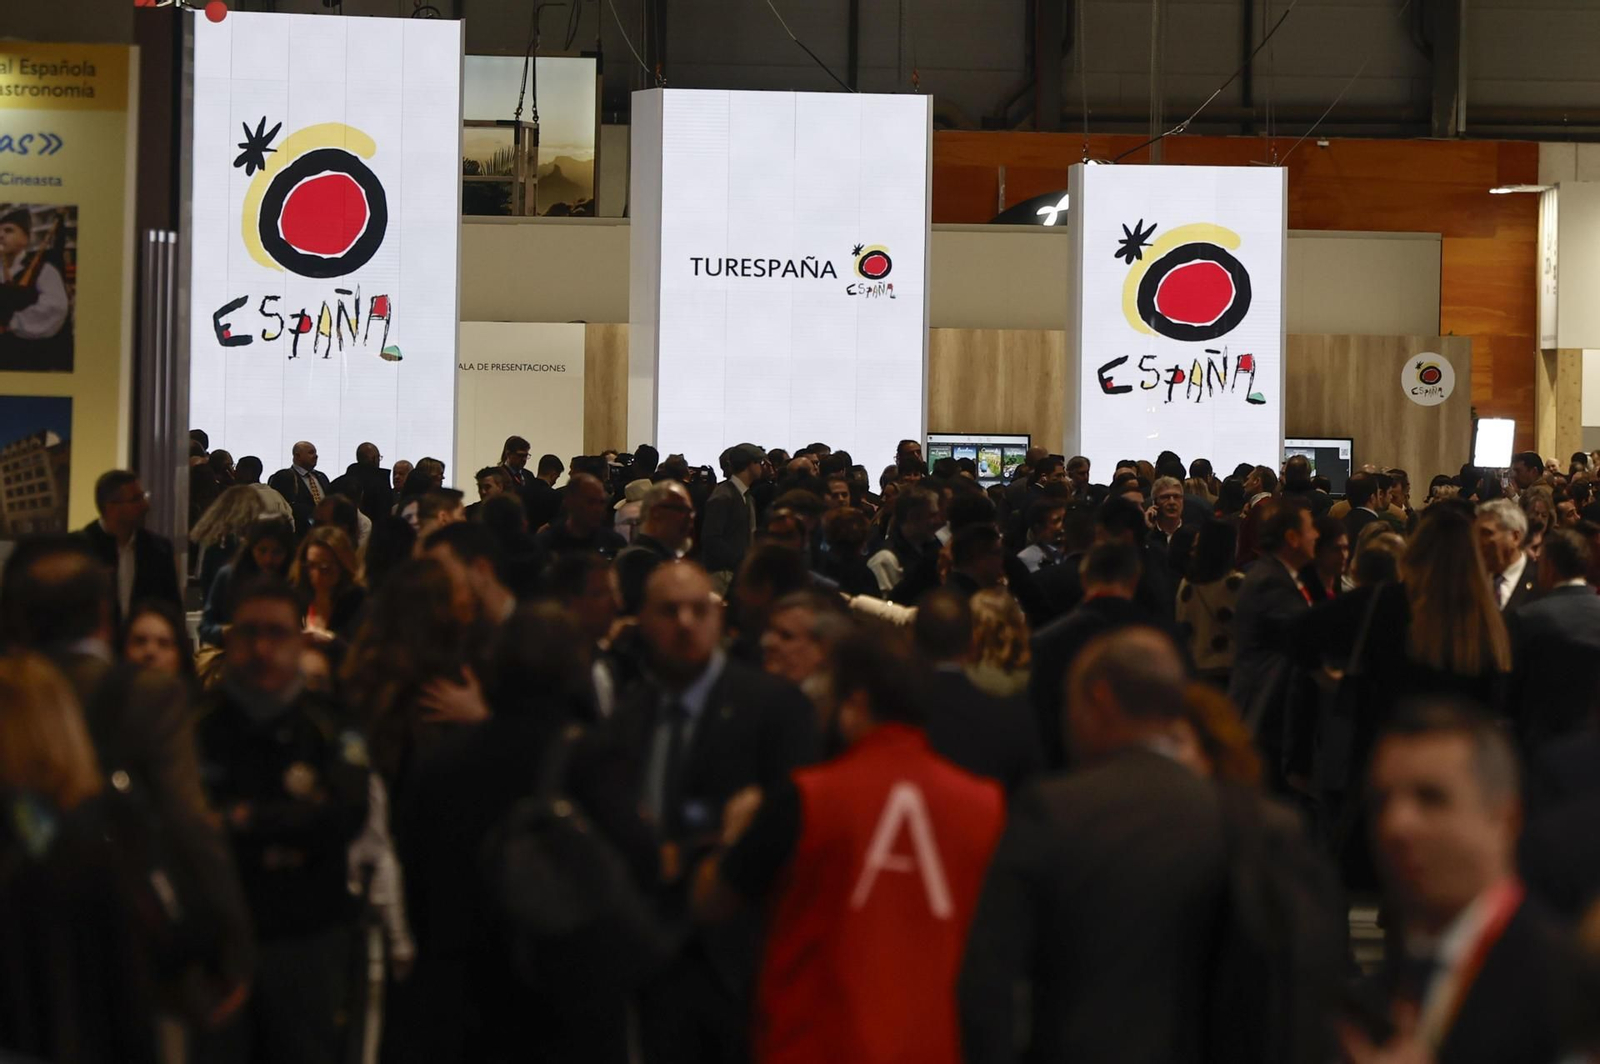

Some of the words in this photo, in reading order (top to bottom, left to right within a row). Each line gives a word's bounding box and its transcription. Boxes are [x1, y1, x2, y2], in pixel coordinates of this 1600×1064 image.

[19, 58, 97, 80] Española
[0, 172, 63, 187] Cineasta
[690, 256, 838, 279] TURESPAÑA
[846, 281, 896, 299] ESPAÑA
[213, 283, 403, 361] ESPAÑA
[477, 363, 489, 371] DE
[491, 363, 566, 373] PRESENTACIONES
[1097, 345, 1266, 405] ESPAÑA
[850, 780, 954, 919] A
